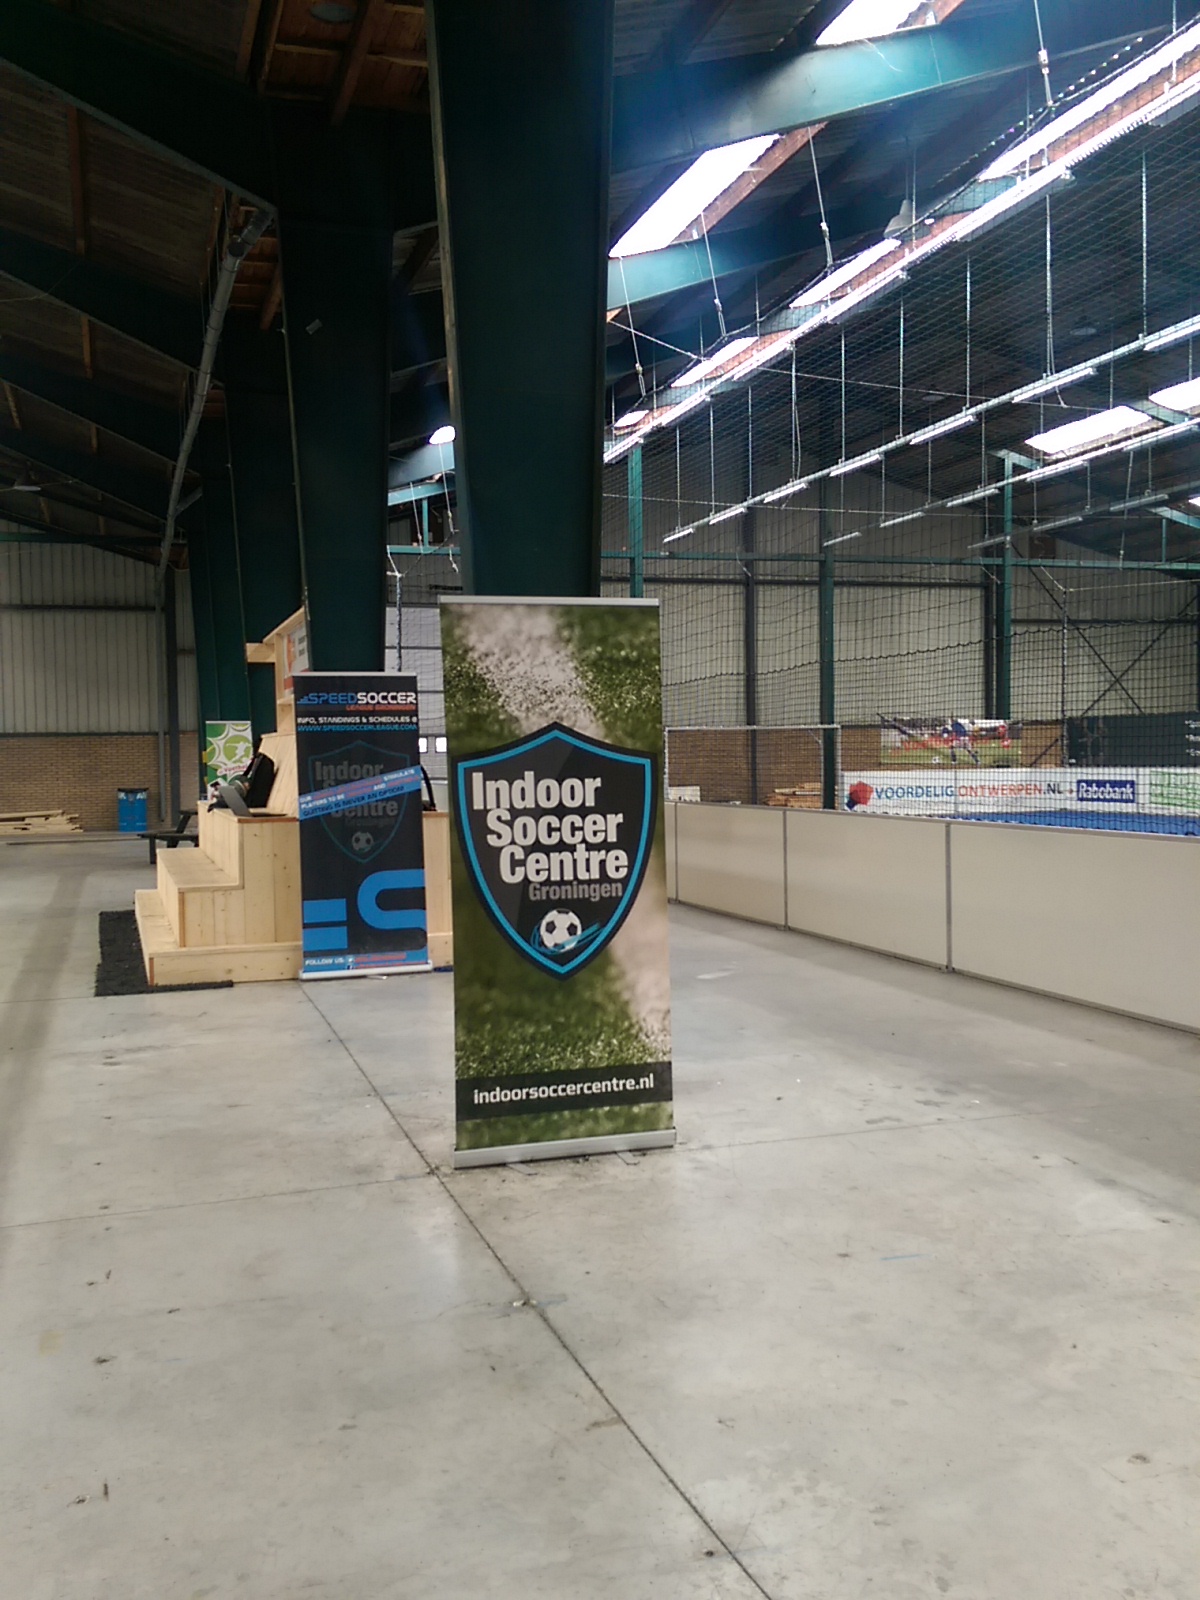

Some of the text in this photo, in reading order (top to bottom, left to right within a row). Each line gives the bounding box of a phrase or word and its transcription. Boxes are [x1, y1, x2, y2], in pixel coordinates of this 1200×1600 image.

[306, 692, 417, 704] SPEEDSOCCER
[315, 761, 384, 780] Indoor
[472, 771, 602, 810] Indoor
[1078, 782, 1134, 800] Rabobank
[486, 808, 624, 847] Soccer
[500, 843, 629, 884] Centre
[529, 882, 623, 902] Groningen
[473, 1073, 654, 1104] indoorsoccercentre.nl
